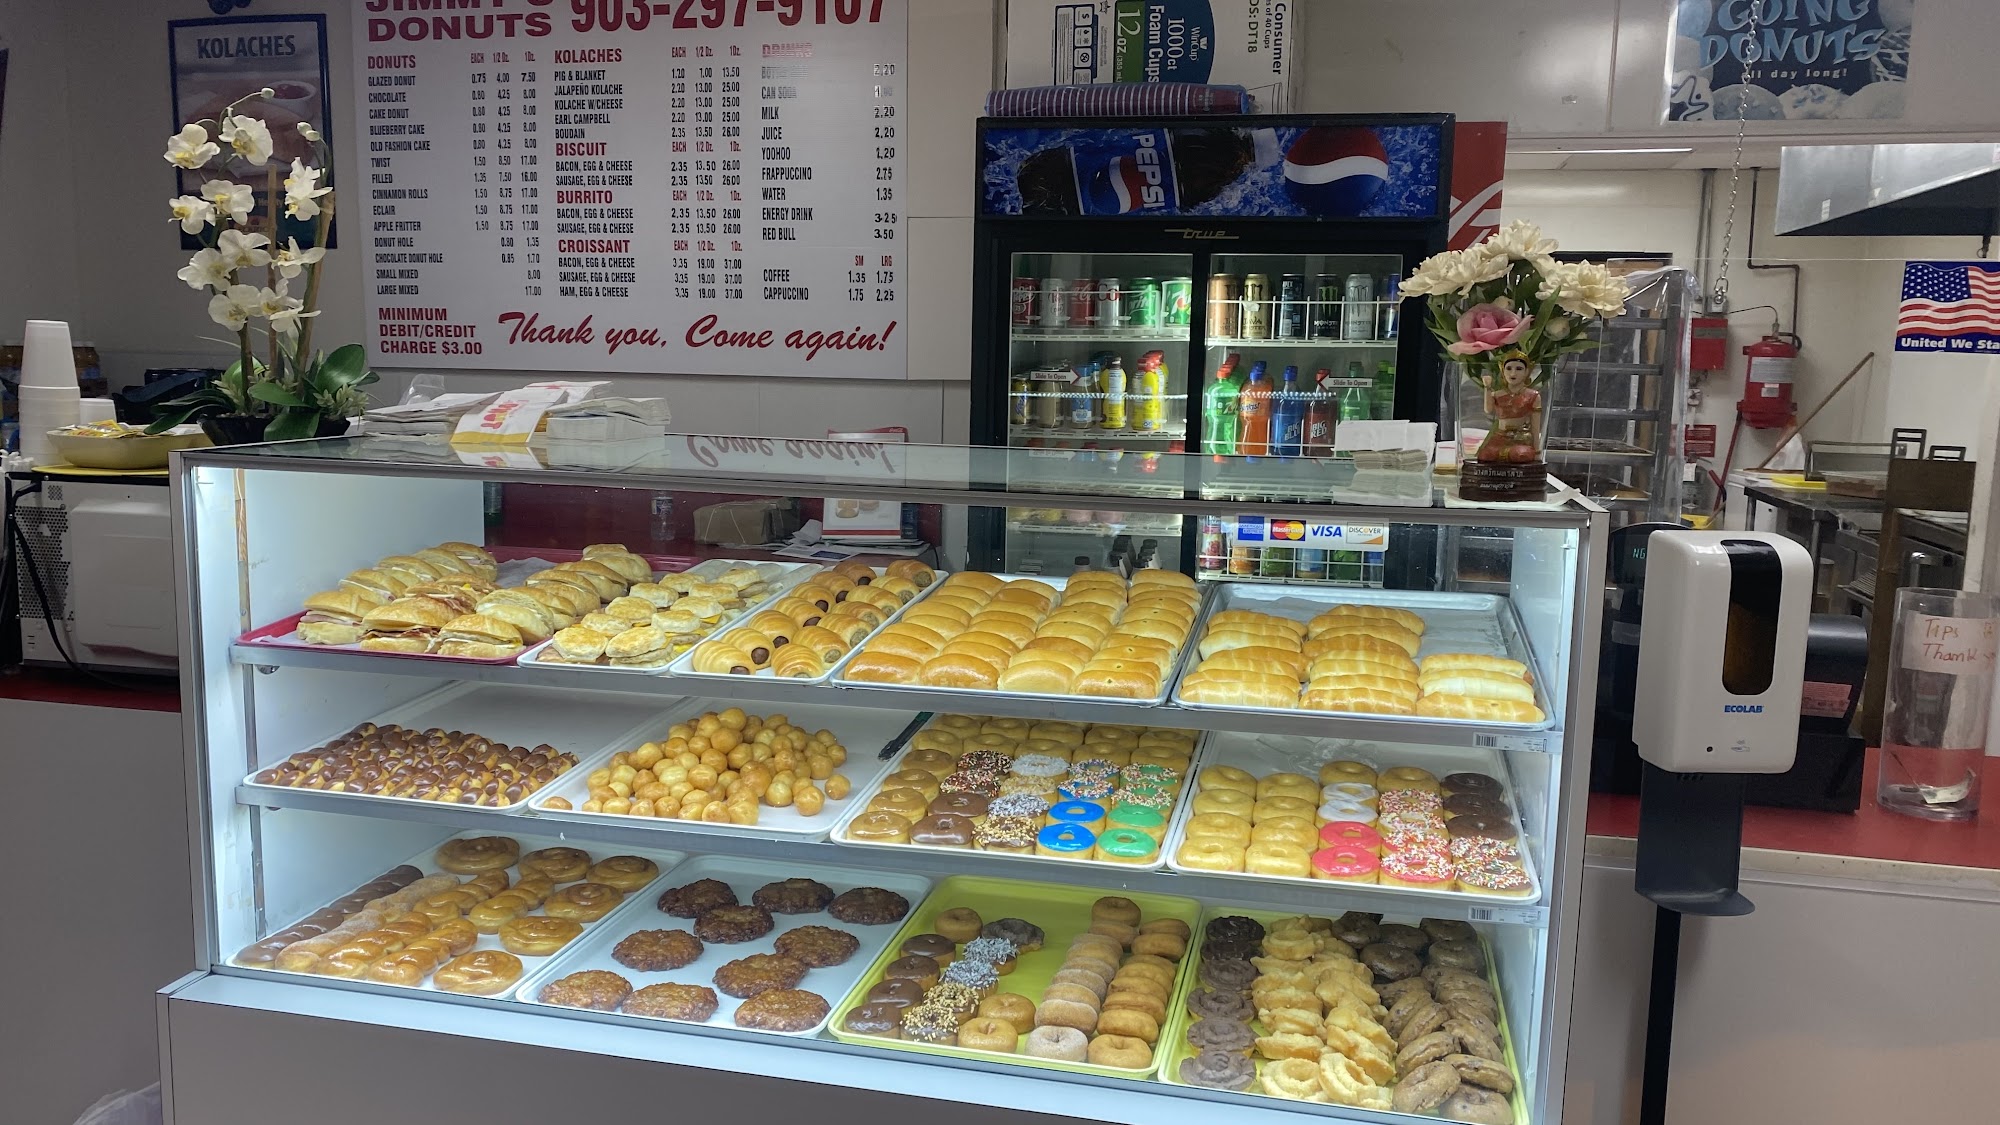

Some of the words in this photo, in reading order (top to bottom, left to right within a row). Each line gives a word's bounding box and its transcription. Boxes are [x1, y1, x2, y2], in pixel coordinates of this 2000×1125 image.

[368, 12, 552, 42] DONUTS
[1149, 5, 1164, 44] Foam
[1264, 18, 1272, 28] 40
[1247, 21, 1259, 53] DT18
[1262, 29, 1272, 49] Cups
[1272, 3, 1287, 75] Consumer
[197, 34, 296, 59] KOLACHES
[1188, 26, 1201, 61] WinCup
[1700, 24, 1886, 71] DONUTS
[555, 48, 622, 63] KOLACHES
[672, 46, 686, 58] EACH
[368, 55, 416, 69] DONUTS
[471, 53, 484, 64] EACH
[1144, 47, 1164, 82] Cups
[368, 76, 392, 86] GLAZED
[394, 76, 416, 86] DONUT
[472, 73, 486, 84] 0.75
[496, 73, 510, 84] 4.00
[521, 72, 536, 82] 7.50
[555, 70, 566, 81] PIG
[575, 70, 605, 80] BLANKET
[1770, 69, 1798, 80] day
[1806, 68, 1848, 78] long!
[554, 83, 589, 96] JALAPEÑO
[591, 84, 623, 95] KOLACHE
[368, 92, 406, 103] CHOCOLATE
[555, 99, 585, 110] KOLACHE
[587, 99, 623, 109] W/CHEESE
[369, 109, 386, 120] CAKE
[388, 108, 409, 119] DONUT
[555, 115, 571, 125] EARL
[574, 114, 610, 124] CAMPBELL
[762, 107, 779, 120] MILK
[370, 125, 406, 136] BLUEBERRY
[408, 124, 425, 135] CAKE
[555, 129, 585, 139] BOUDAIN
[672, 128, 685, 138] 2.35
[762, 127, 782, 140] JUICE
[875, 128, 894, 139] 2.20
[371, 142, 383, 152] OLD
[385, 141, 412, 151] FASHION
[413, 140, 430, 150] CAKE
[556, 143, 607, 156] BISCUIT
[672, 142, 686, 152] EACH
[762, 147, 790, 160] YOOHOO
[371, 158, 390, 168] TWIST
[556, 161, 581, 172] BACON,
[583, 161, 596, 171] EGG
[605, 161, 632, 171] CHEESE
[671, 162, 687, 172] 2.35
[762, 167, 812, 180] FRAPPUCCINO
[876, 167, 892, 180] 2.75
[1132, 133, 1166, 210] PEPSI
[372, 174, 392, 184] FILLED
[556, 175, 585, 186] SAUSAGE,
[587, 175, 600, 186] EGG
[608, 175, 632, 186] CHEESE
[671, 176, 688, 186] 2.35
[372, 189, 406, 199] CINNAMON
[408, 189, 428, 199] ROLLS
[557, 190, 612, 204] BURRITO
[673, 190, 687, 201] EACH
[762, 188, 786, 200] WATER
[876, 188, 892, 200] 1.35
[373, 206, 395, 215] ECLAIR
[557, 208, 582, 220] BACON,
[584, 208, 597, 218] EGG
[606, 208, 633, 218] CHEESE
[672, 208, 690, 218] 2.35
[762, 208, 789, 220] ENERGY
[791, 208, 813, 220] DRINK
[374, 222, 393, 231] APPLE
[396, 221, 421, 231] FRITTER
[557, 223, 587, 234] SAUSAGE,
[589, 223, 601, 233] EGG
[610, 223, 634, 233] CHEESE
[672, 223, 690, 233] 2.35
[763, 228, 776, 240] RED
[779, 228, 796, 240] BULL
[874, 229, 894, 239] 3.50
[375, 238, 395, 247] DONUT
[398, 238, 413, 247] HOLE
[527, 237, 539, 247] 1.35
[558, 240, 630, 253] CROISSANT
[674, 240, 688, 251] EACH
[375, 253, 407, 263] CHOCOLATE
[409, 253, 427, 263] DONUT
[429, 253, 443, 263] HOLE
[558, 257, 584, 268] BACON,
[586, 257, 599, 268] EGG
[608, 258, 635, 268] CHEESE
[855, 255, 864, 266] SM
[882, 256, 892, 266] LRG
[376, 269, 398, 279] SMALL
[399, 269, 418, 279] MIXED
[559, 272, 589, 283] SAUSAGE,
[590, 272, 602, 282] EGG
[611, 272, 635, 282] CHEESE
[763, 269, 790, 282] COFFEE
[848, 270, 866, 283] 1.35
[876, 270, 894, 283] 1.75
[377, 285, 397, 295] LARGE
[399, 285, 419, 295] MIXED
[560, 287, 577, 298] HAM,
[580, 287, 592, 296] EGG
[602, 287, 628, 297] CHEESE
[764, 287, 809, 300] CAPPUCCINO
[848, 288, 864, 301] 1.75
[876, 289, 894, 302] 2.25
[378, 308, 447, 321] MINIMUM
[380, 324, 476, 338] DEBIT/CREDIT
[498, 312, 596, 345] Thank
[604, 324, 668, 355] you,
[685, 314, 775, 348] Come
[784, 320, 898, 362] again!
[381, 340, 436, 354] CHARGE
[442, 341, 482, 355] $3.00
[1901, 338, 1947, 348] United
[1951, 339, 1973, 348] We
[1312, 526, 1342, 537] VISA
[1926, 618, 1959, 640] Tips
[1923, 643, 1978, 662] Thank
[1724, 704, 1764, 713] ECOLAB
